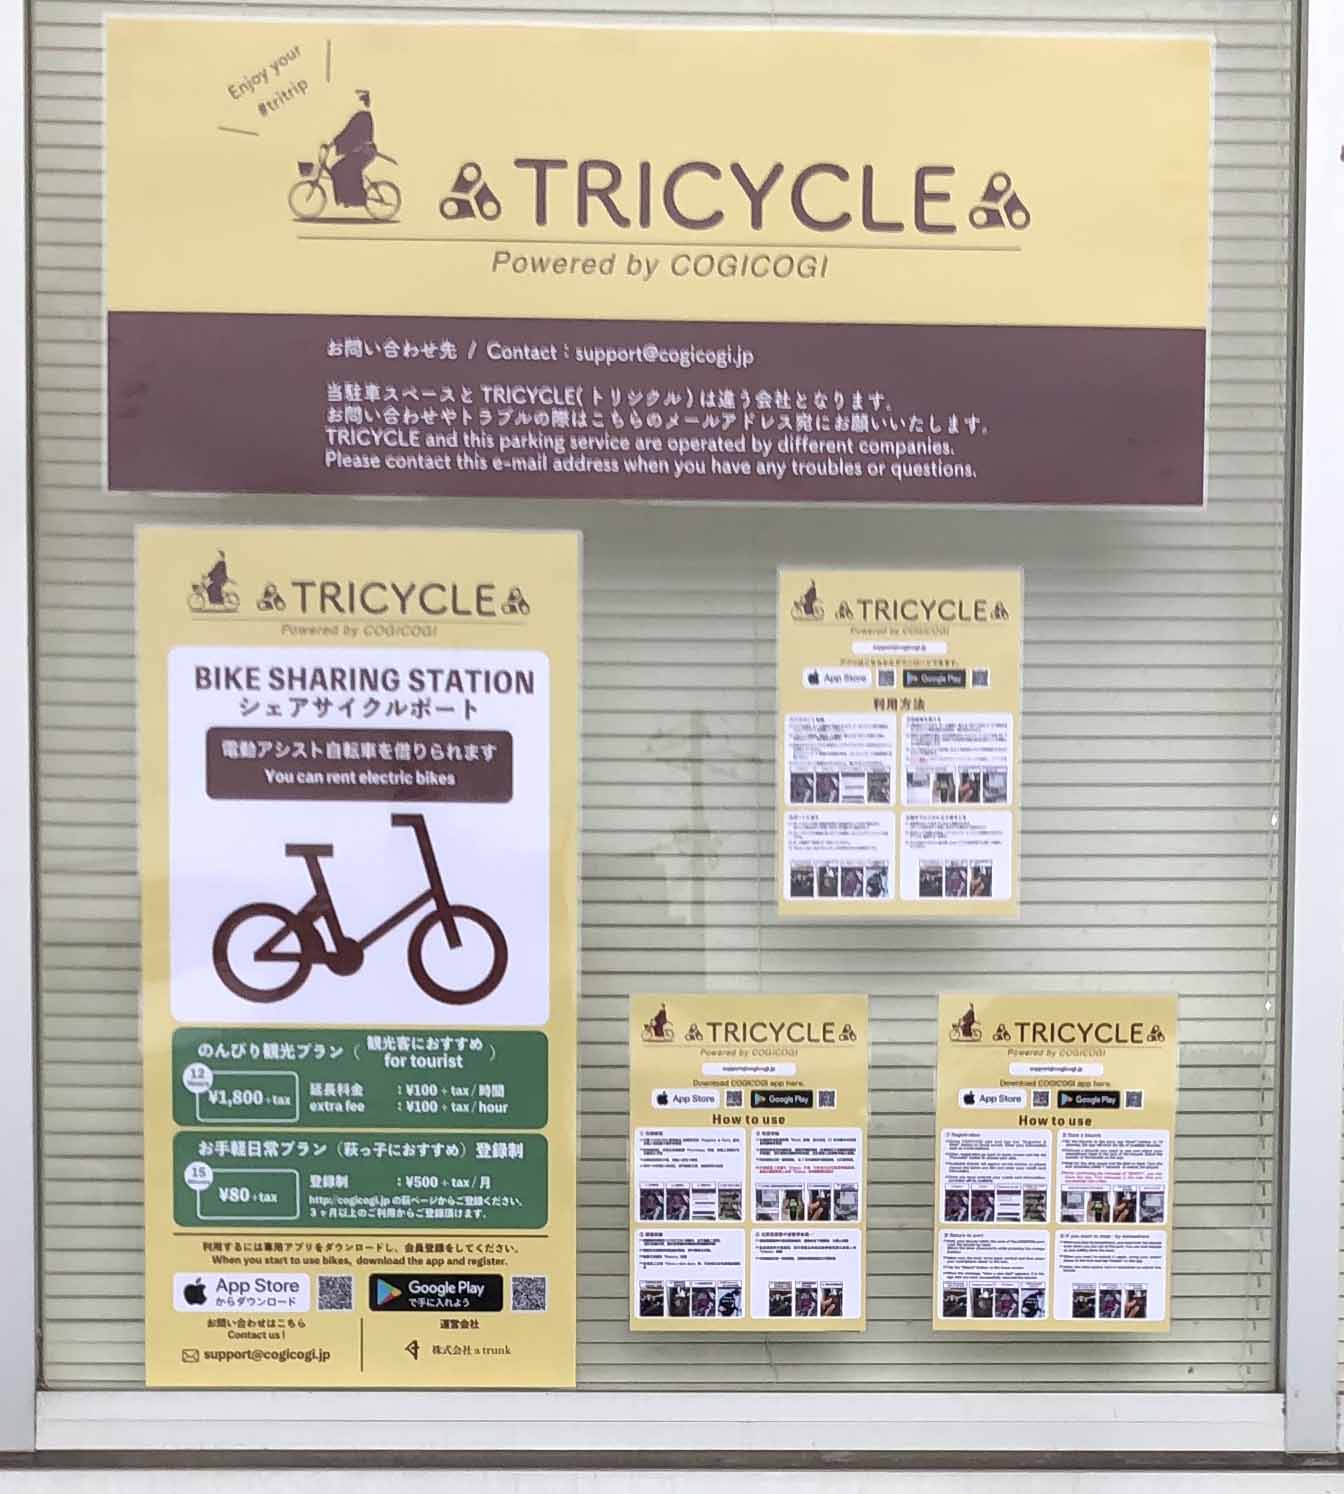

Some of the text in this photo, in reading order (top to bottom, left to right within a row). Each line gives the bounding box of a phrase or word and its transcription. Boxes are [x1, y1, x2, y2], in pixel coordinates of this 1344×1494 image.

[227, 43, 303, 101] Enjoy your
[513, 157, 957, 234] TRICYCLE
[491, 250, 828, 280] Powered by COGICOGI
[327, 338, 457, 360] お問い合わせ先
[575, 343, 754, 367] support@cogicogi.jp
[325, 427, 955, 459] TRICYCLE and this parking service are operated by different companies.
[325, 448, 977, 481] Please contact this e-mail address when you have any troubles or questions.
[292, 580, 497, 617] TRICYCLE
[855, 599, 987, 622] TRICYCLE
[281, 624, 438, 638] Powered by COGICOGI
[194, 666, 535, 695] BIKE SHARING STATION
[222, 740, 496, 762] 電動アシスト自転車を借りられます
[264, 768, 456, 786] You can rent electric bikes
[706, 1022, 835, 1044] TRICYCLE
[1014, 1022, 1144, 1044] TRICYCLE
[197, 1043, 343, 1060] のんびり観光プラン
[384, 1054, 464, 1069] for tourist
[407, 1084, 438, 1097] ¥100
[451, 1086, 469, 1097] tax
[479, 1084, 505, 1098] 時間
[309, 1100, 508, 1113] extra fee ¥100 tax hour
[672, 1094, 809, 1106] App Store Google Play
[979, 1094, 1116, 1107] App Store Google Play
[712, 1114, 786, 1125] How to use
[1019, 1115, 1093, 1127] How to use
[407, 1176, 490, 1189] ¥500 tax 月
[219, 1187, 250, 1202] ¥80
[212, 1255, 508, 1267] When you start to use bikes, download the app and register.
[216, 1278, 485, 1297] App Store Google Play
[216, 1297, 470, 1308] からダウンロード で手に入れよう
[207, 1318, 306, 1329] お問い合わせはこちら
[228, 1330, 266, 1340] Contact
[204, 1349, 331, 1363] support@cogicogi.jp
